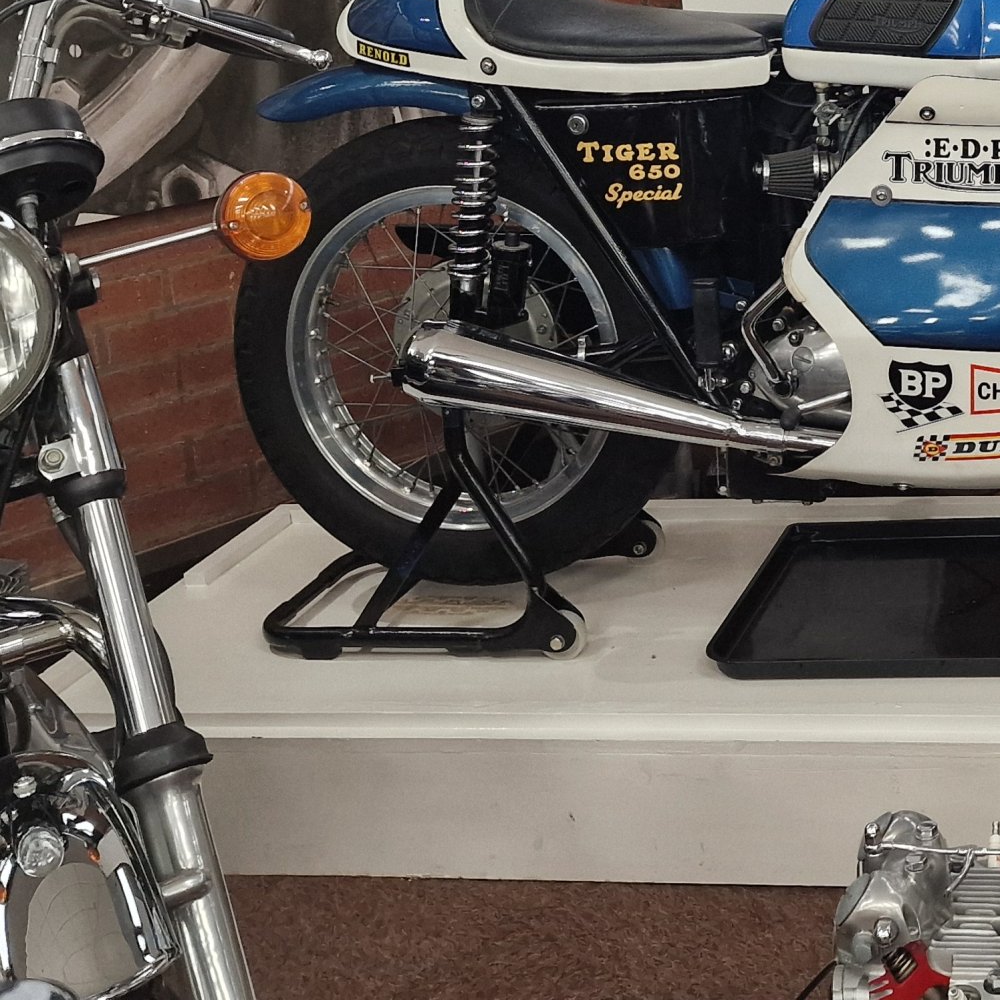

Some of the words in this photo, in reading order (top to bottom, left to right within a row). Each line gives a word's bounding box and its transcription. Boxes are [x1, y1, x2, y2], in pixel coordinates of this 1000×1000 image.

[358, 42, 408, 66] RENOLD
[577, 141, 680, 163] TIGER
[628, 163, 681, 180] 650
[604, 182, 683, 209] Special
[897, 368, 948, 399] BP
